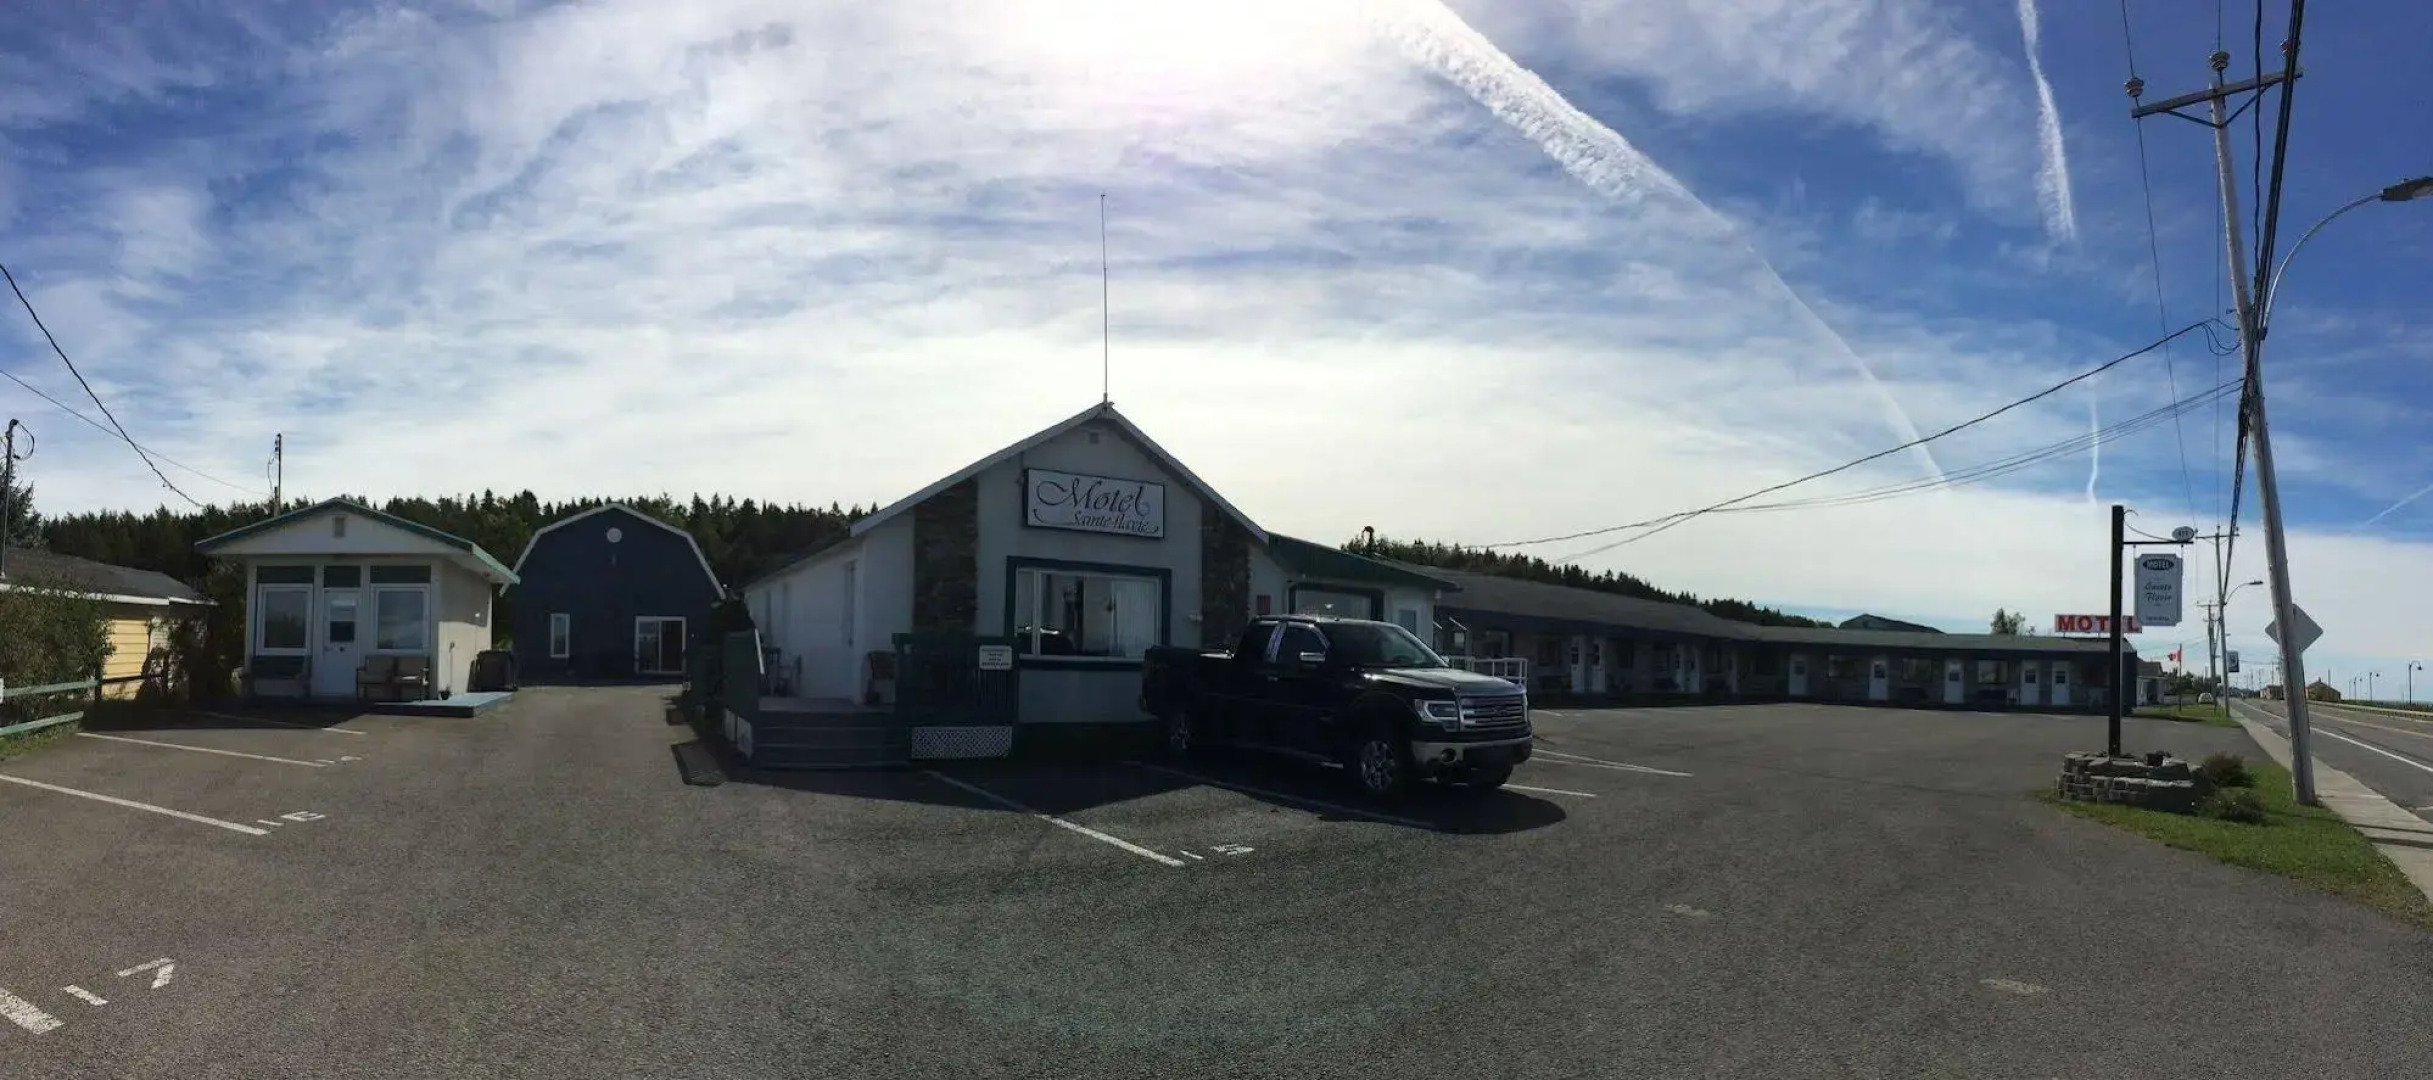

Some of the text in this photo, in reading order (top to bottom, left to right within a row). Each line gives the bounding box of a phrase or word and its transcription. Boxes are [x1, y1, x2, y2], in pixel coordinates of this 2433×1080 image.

[1036, 477, 1151, 517] Motel
[2147, 560, 2170, 570] MOTEL
[2057, 615, 2140, 632] MOTL
[60, 956, 175, 1007] 17
